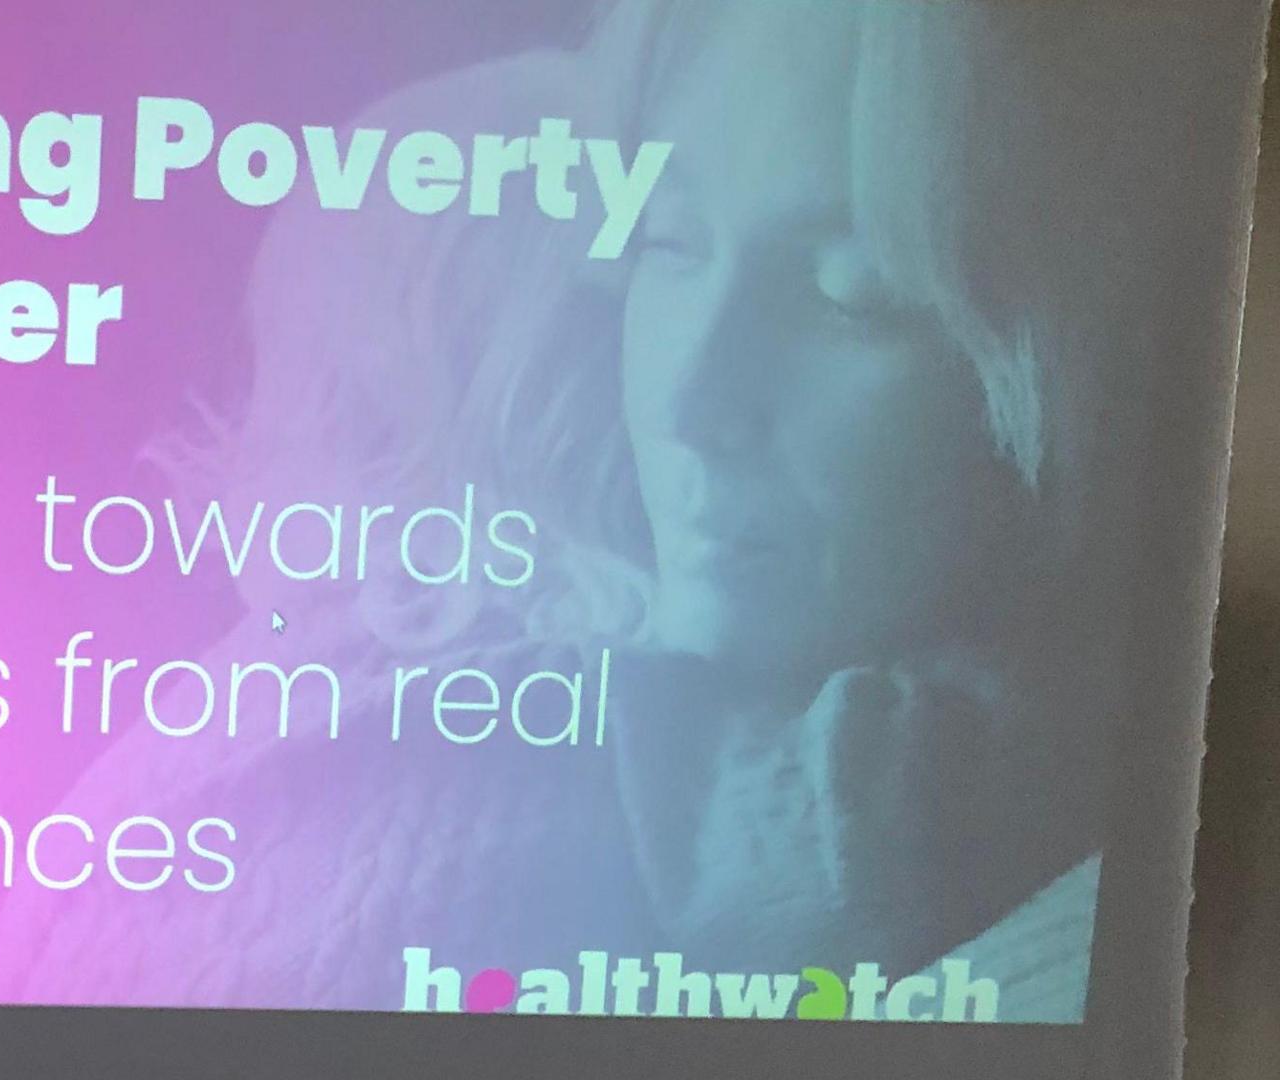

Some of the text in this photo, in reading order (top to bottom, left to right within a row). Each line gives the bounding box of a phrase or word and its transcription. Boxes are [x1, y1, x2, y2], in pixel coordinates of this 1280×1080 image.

[134, 96, 674, 260] Poverty
[36, 475, 537, 587] towards
[55, 631, 340, 739] from
[392, 648, 610, 746] real
